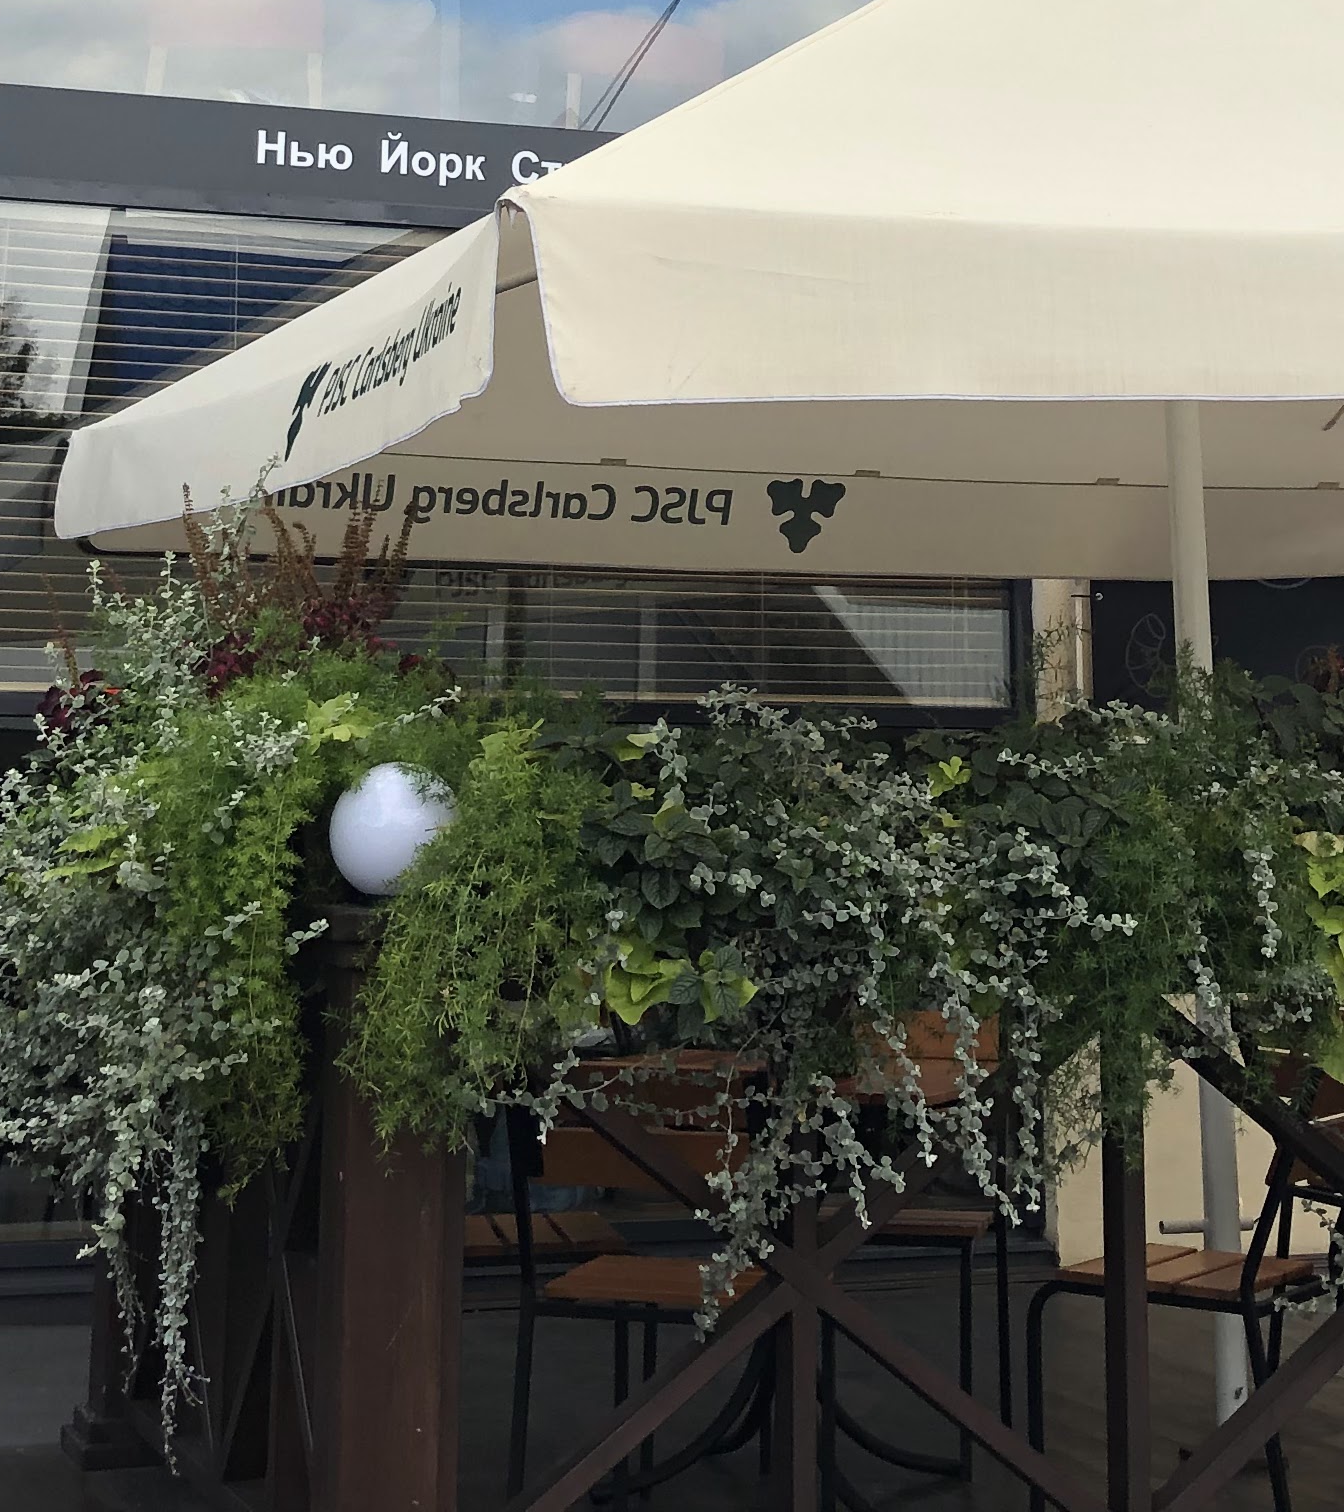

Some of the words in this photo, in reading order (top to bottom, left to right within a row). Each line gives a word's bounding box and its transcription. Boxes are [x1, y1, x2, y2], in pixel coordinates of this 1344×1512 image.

[256, 129, 354, 171] Нью
[379, 131, 486, 187] Йорк
[510, 150, 564, 185] Ст
[317, 354, 362, 418] PJSC
[352, 328, 416, 400] Carlsberg
[412, 281, 462, 363] Ukraine
